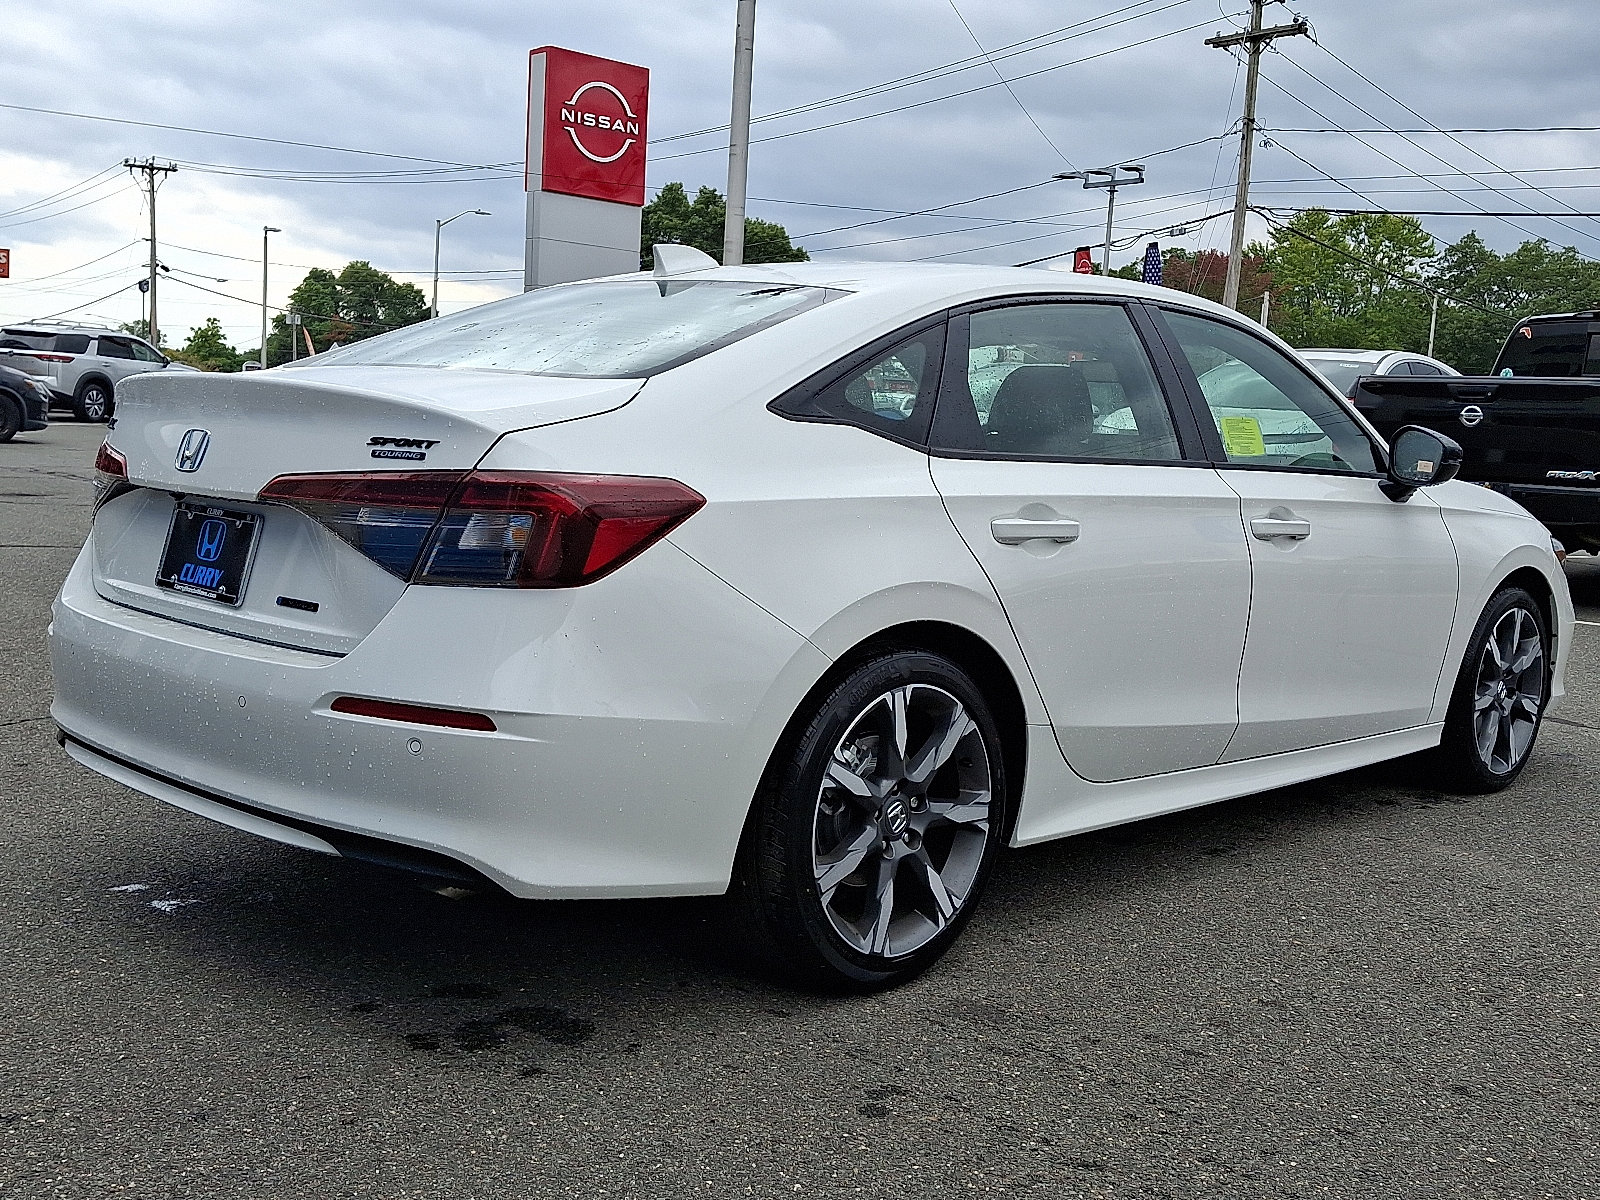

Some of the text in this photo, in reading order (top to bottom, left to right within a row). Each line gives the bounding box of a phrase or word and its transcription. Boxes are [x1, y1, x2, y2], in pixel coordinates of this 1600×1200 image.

[561, 108, 639, 135] NISSAN
[366, 437, 441, 449] SPORT
[374, 450, 421, 458] TOURING
[207, 508, 225, 516] CURRY
[179, 563, 225, 588] CURRY
